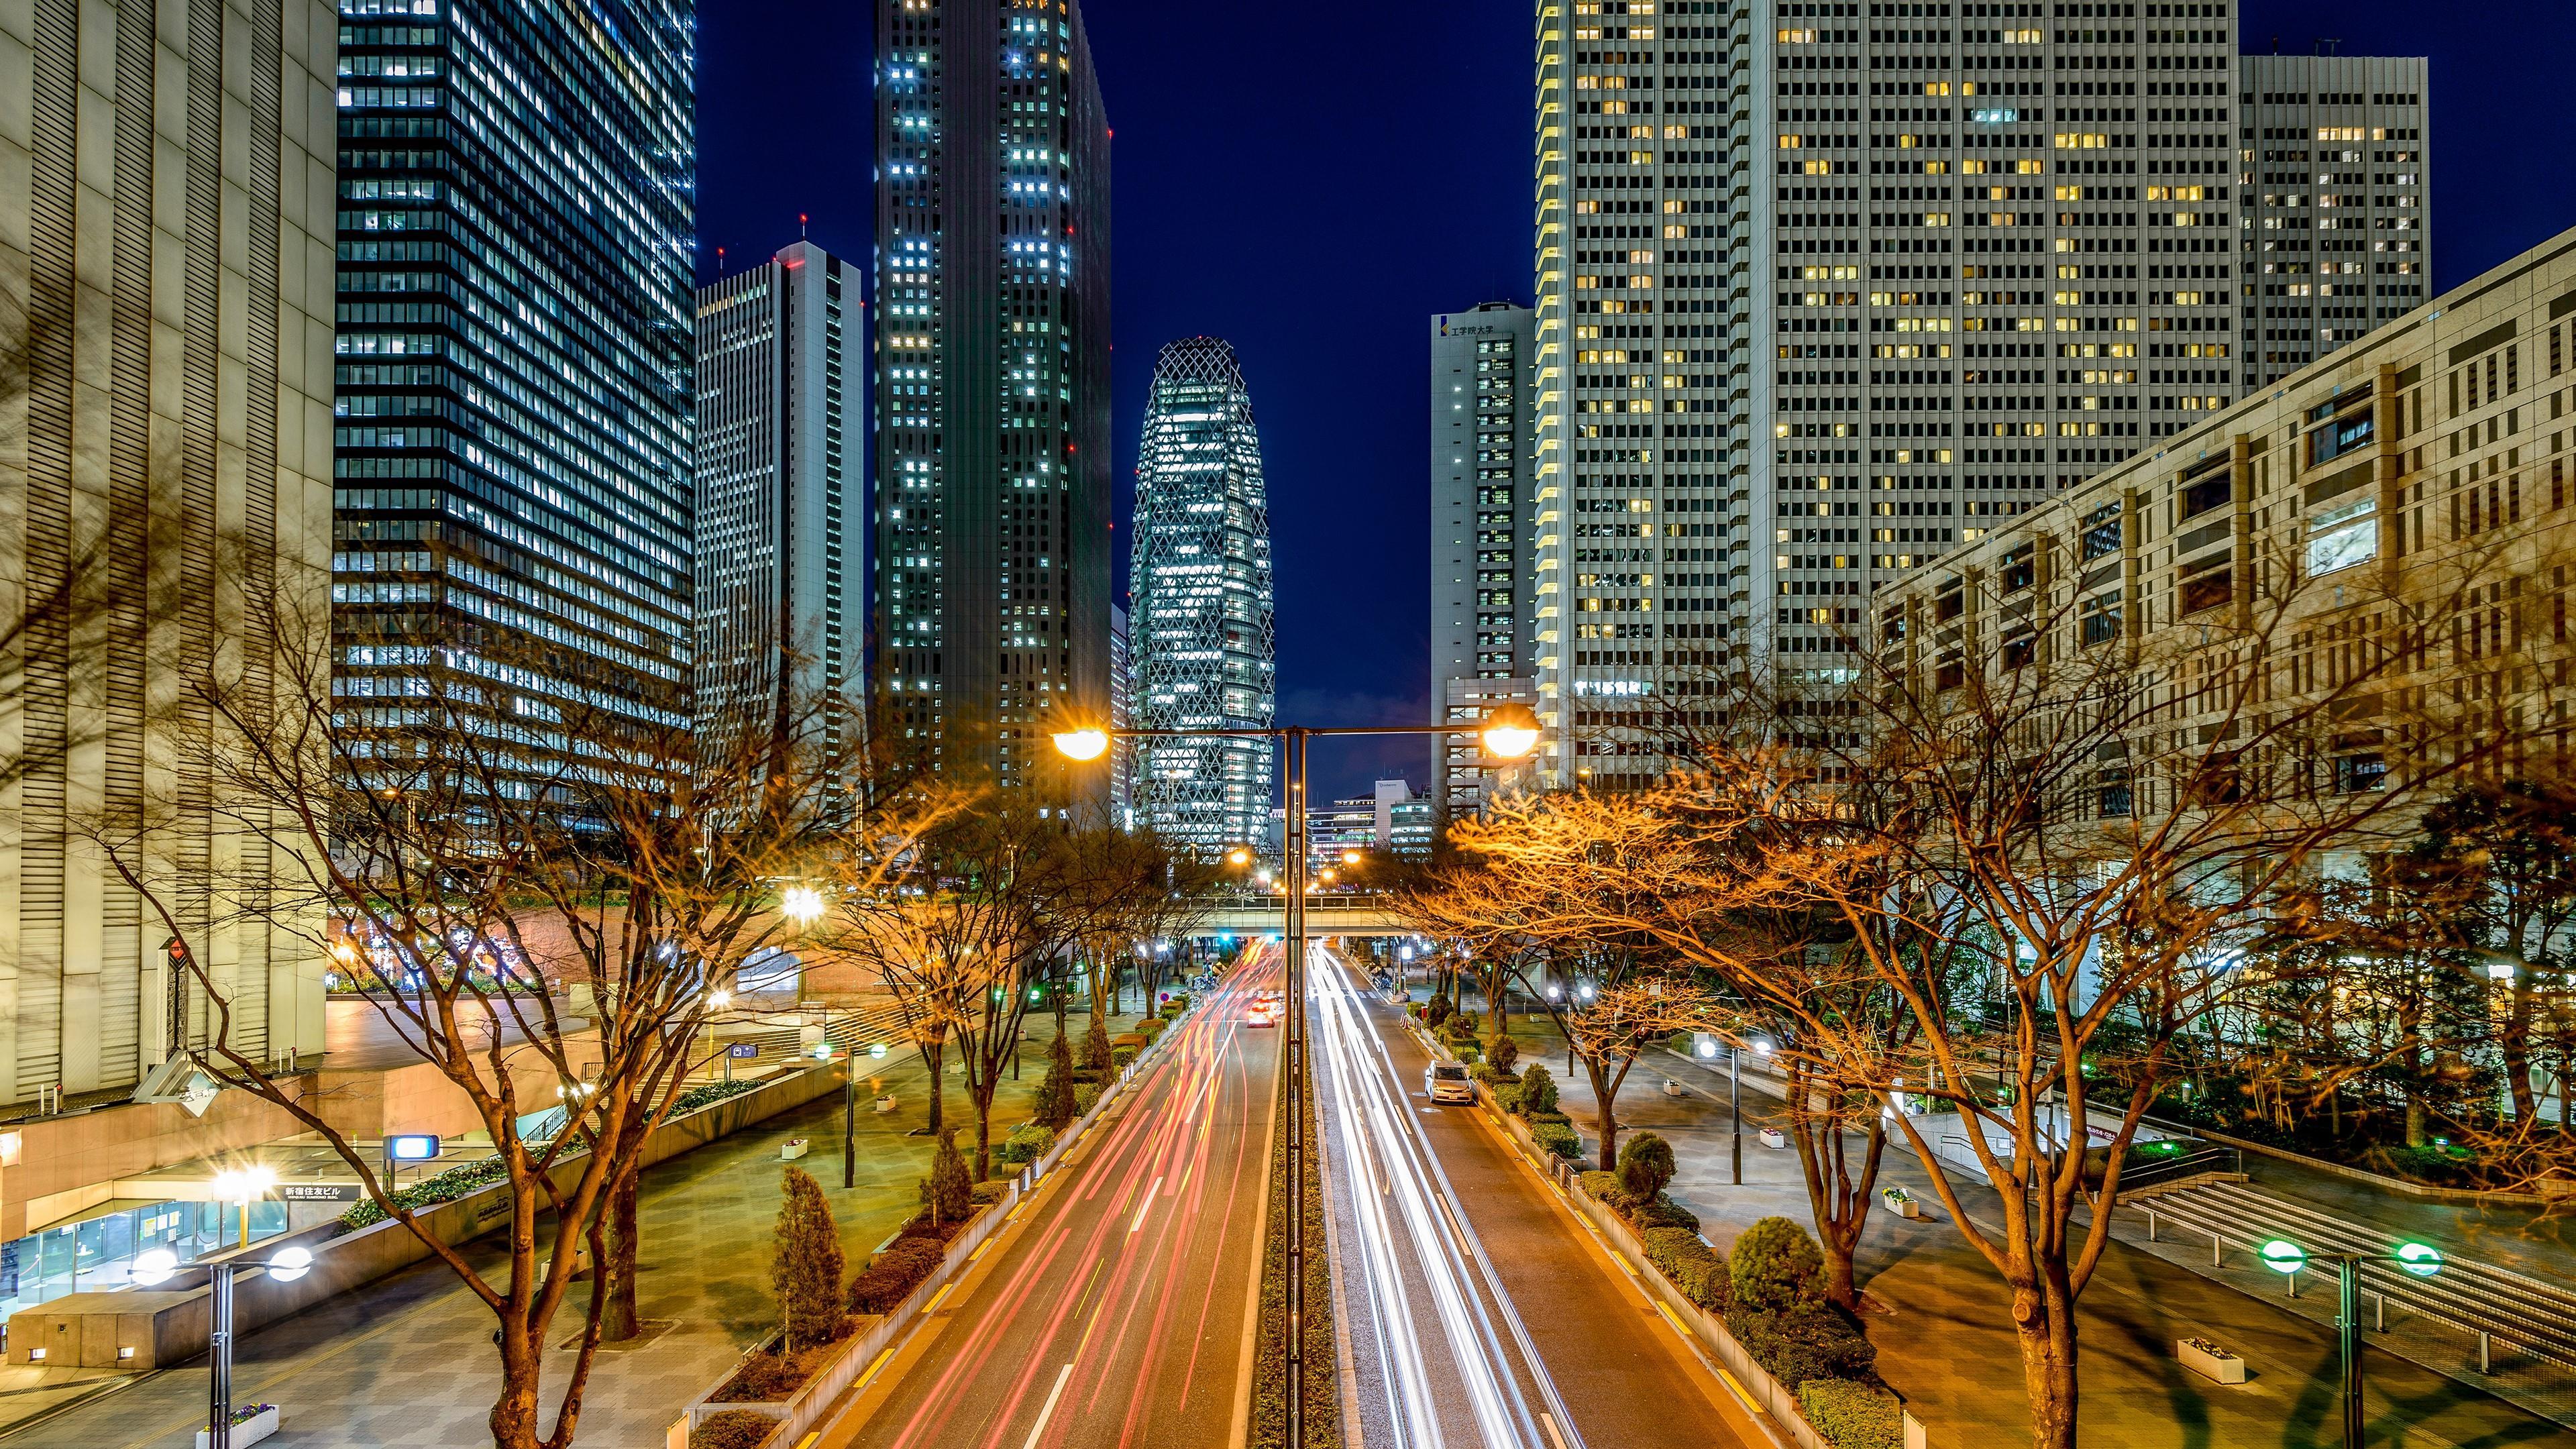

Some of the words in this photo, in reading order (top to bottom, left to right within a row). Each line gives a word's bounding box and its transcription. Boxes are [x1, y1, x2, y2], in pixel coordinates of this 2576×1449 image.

[1451, 325, 1494, 336] 工学院大学
[285, 1187, 341, 1195] 新宿住友ビル
